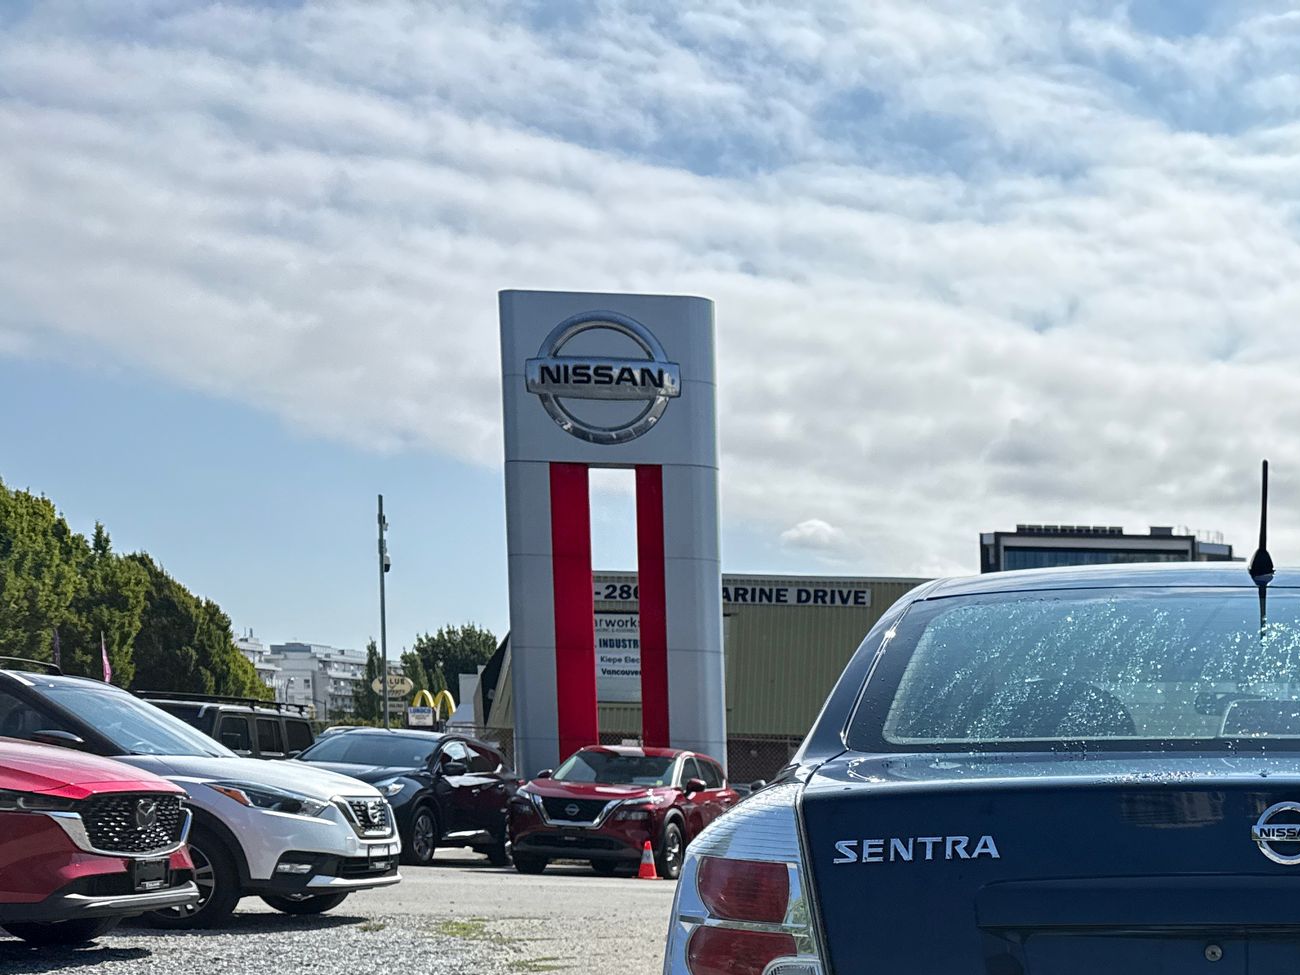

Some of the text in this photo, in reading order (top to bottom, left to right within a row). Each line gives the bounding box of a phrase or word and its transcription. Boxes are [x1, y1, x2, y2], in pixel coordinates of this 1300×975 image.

[540, 364, 664, 388] NISSAN
[722, 586, 789, 603] ARINE
[796, 588, 867, 605] DRIVE
[832, 835, 1001, 864] SENTRA
